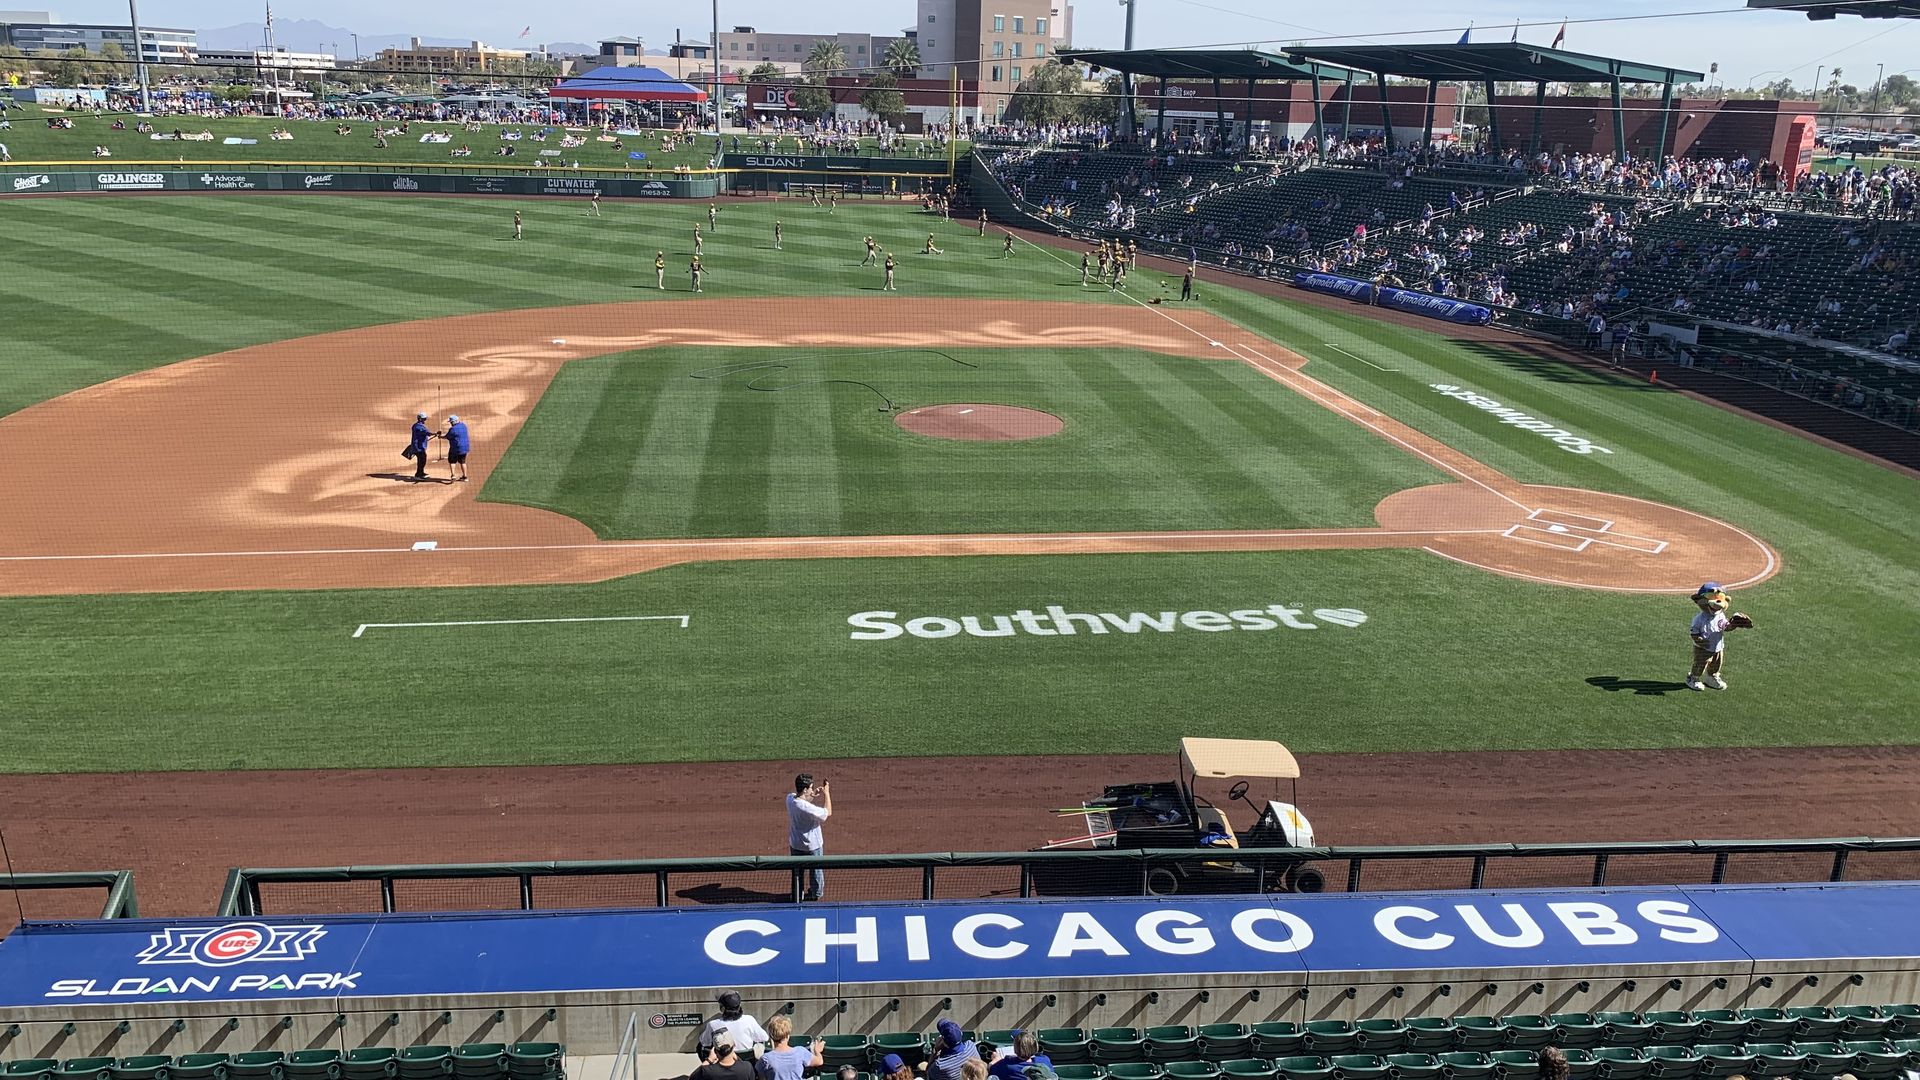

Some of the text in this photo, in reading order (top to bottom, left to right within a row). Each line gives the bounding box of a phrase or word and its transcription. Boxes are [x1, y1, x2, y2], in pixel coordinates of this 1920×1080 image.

[766, 89, 798, 107] DEC
[97, 173, 164, 184] GRAINGER
[214, 174, 246, 182] Advocate
[214, 181, 238, 189] Health
[547, 178, 595, 188] CUTWATER
[1305, 275, 1353, 295] Reynolds Wrap
[1393, 291, 1451, 313] Reynolds Wrap
[1439, 389, 1614, 454] Southwest
[847, 604, 1319, 640] Southwest
[703, 900, 1720, 967] CHICAGO CUBS
[44, 971, 363, 998] SLOAN PARK
